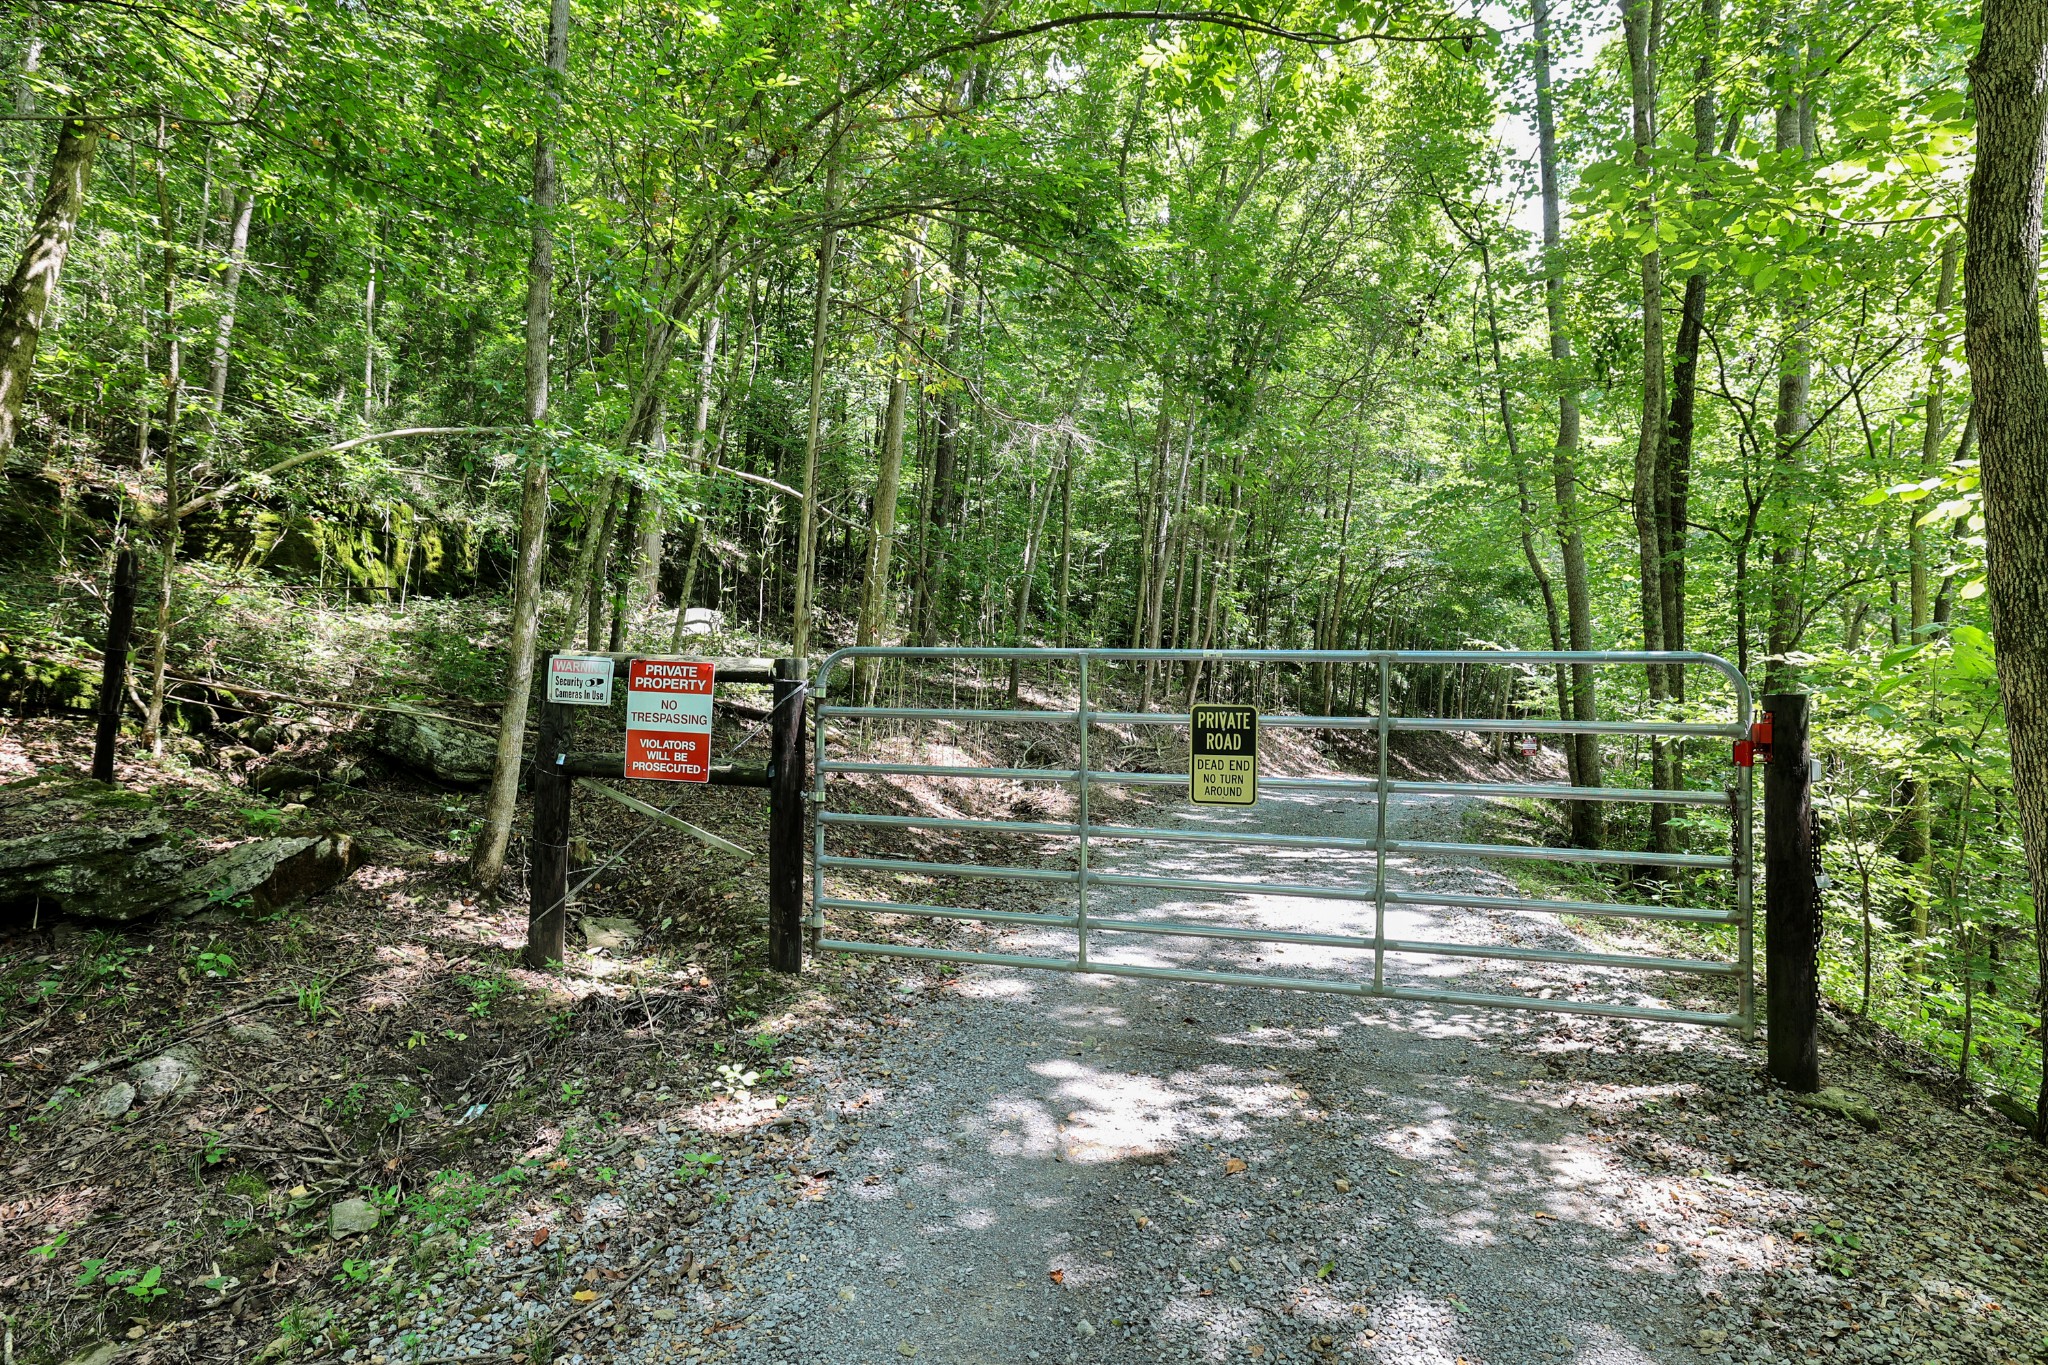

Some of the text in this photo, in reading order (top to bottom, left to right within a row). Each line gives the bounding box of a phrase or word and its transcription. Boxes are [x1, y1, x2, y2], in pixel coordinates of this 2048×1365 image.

[556, 660, 607, 673] WARNING
[645, 665, 697, 677] PRIVATE
[555, 676, 583, 688] Security
[635, 677, 707, 690] PROPERTY
[555, 690, 603, 700] Cameras In Use
[661, 700, 678, 711] NO
[631, 712, 707, 725] TRESPASSING
[1198, 712, 1250, 729] PRIVATE
[640, 739, 696, 751] VIOLATORS
[1206, 733, 1241, 750] ROAD
[647, 751, 687, 762] WILL BE
[632, 762, 701, 774] PROSECUTED
[1198, 759, 1250, 771] DEAD END
[1203, 773, 1244, 784] NO TURN
[1205, 786, 1242, 796] AROUND
